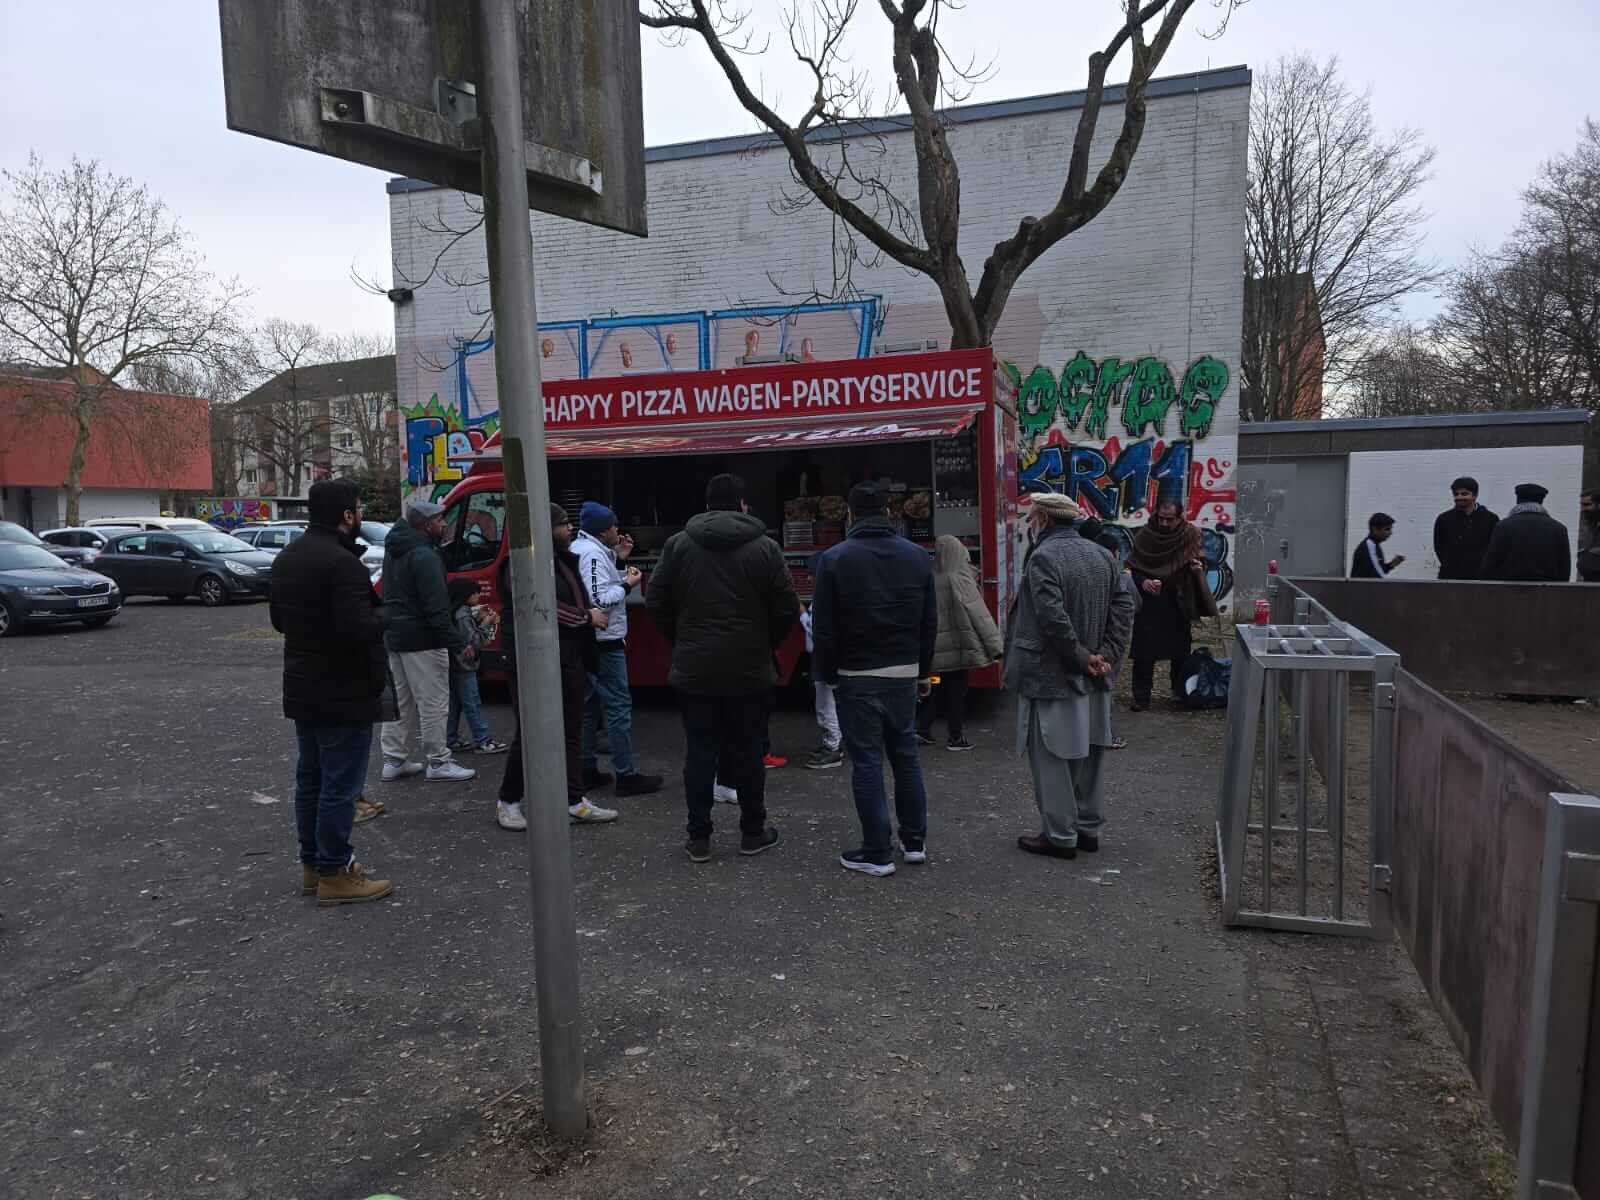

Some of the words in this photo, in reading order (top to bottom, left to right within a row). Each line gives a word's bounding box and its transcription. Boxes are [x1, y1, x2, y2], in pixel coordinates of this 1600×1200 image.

[542, 393, 613, 422] HAPYY
[621, 388, 687, 418] PIZZA
[693, 367, 982, 414] WAGEN-PARTYSERVICE
